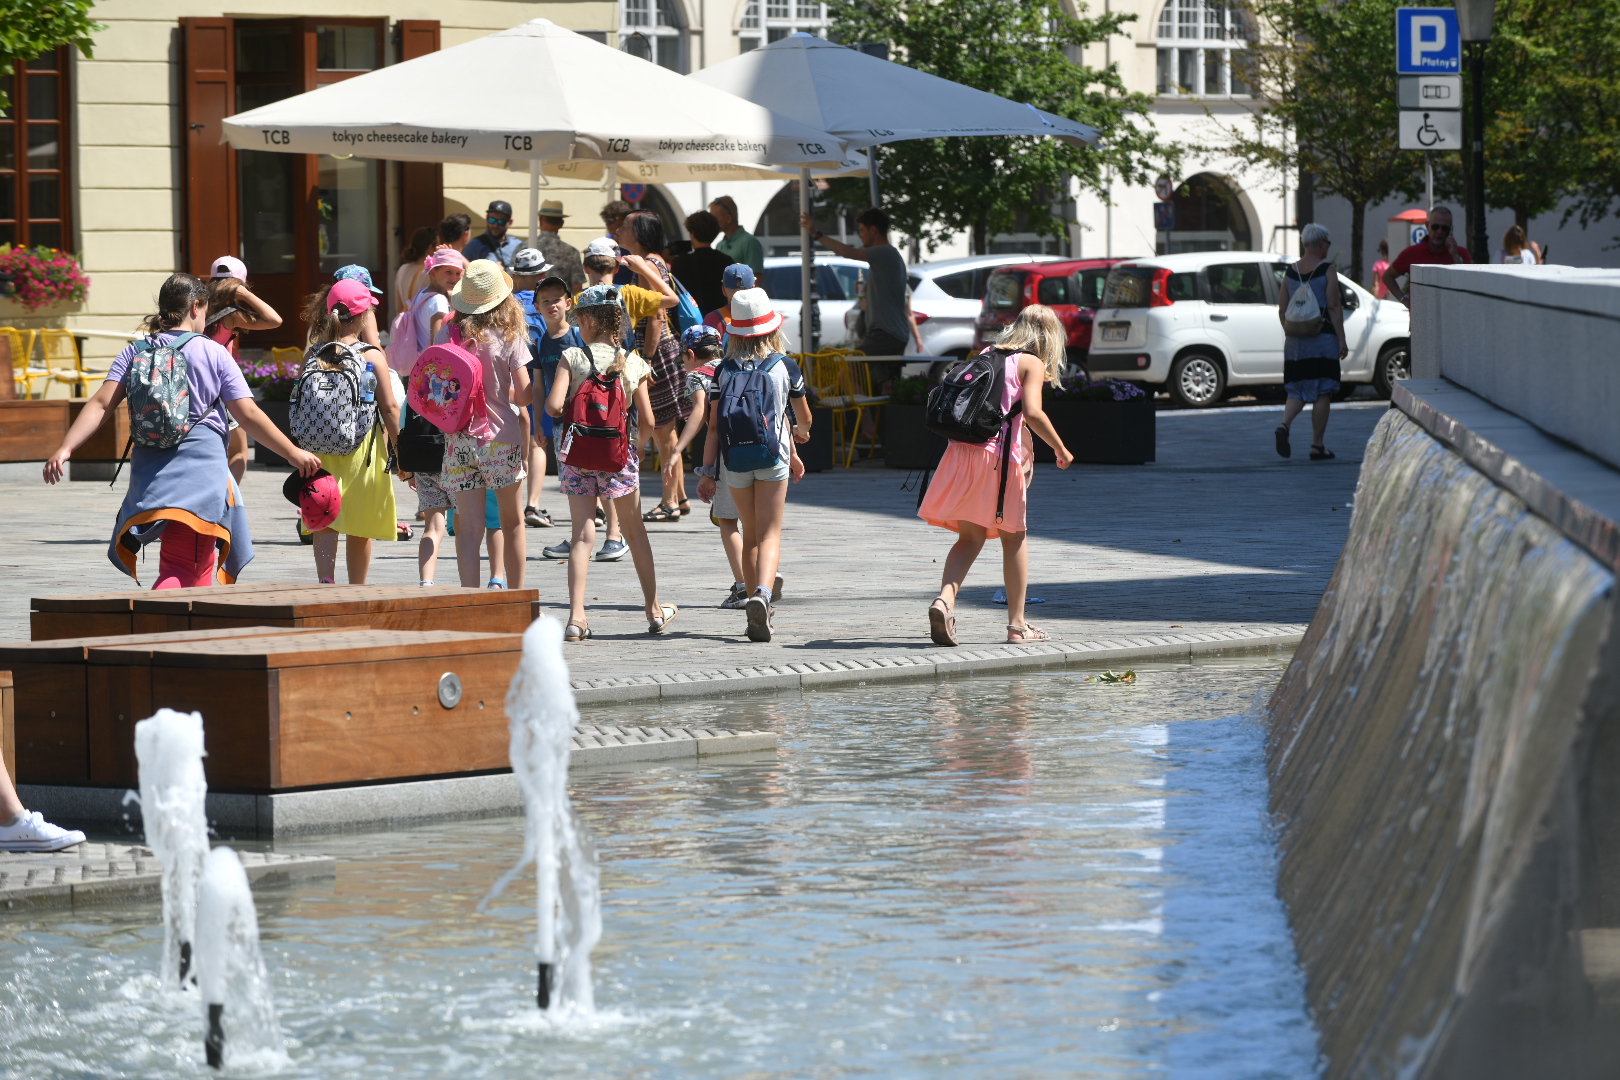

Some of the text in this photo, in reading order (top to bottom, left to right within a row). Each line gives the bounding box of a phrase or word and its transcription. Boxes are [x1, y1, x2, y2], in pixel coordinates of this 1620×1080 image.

[1411, 15, 1446, 66] P
[262, 130, 290, 145] TCB
[332, 129, 468, 148] tokyo cheesecake bakery
[503, 135, 533, 151] TCB
[606, 138, 630, 153] TCB
[658, 138, 767, 155] tokyo cheesecake bakery
[797, 142, 826, 156] TCB
